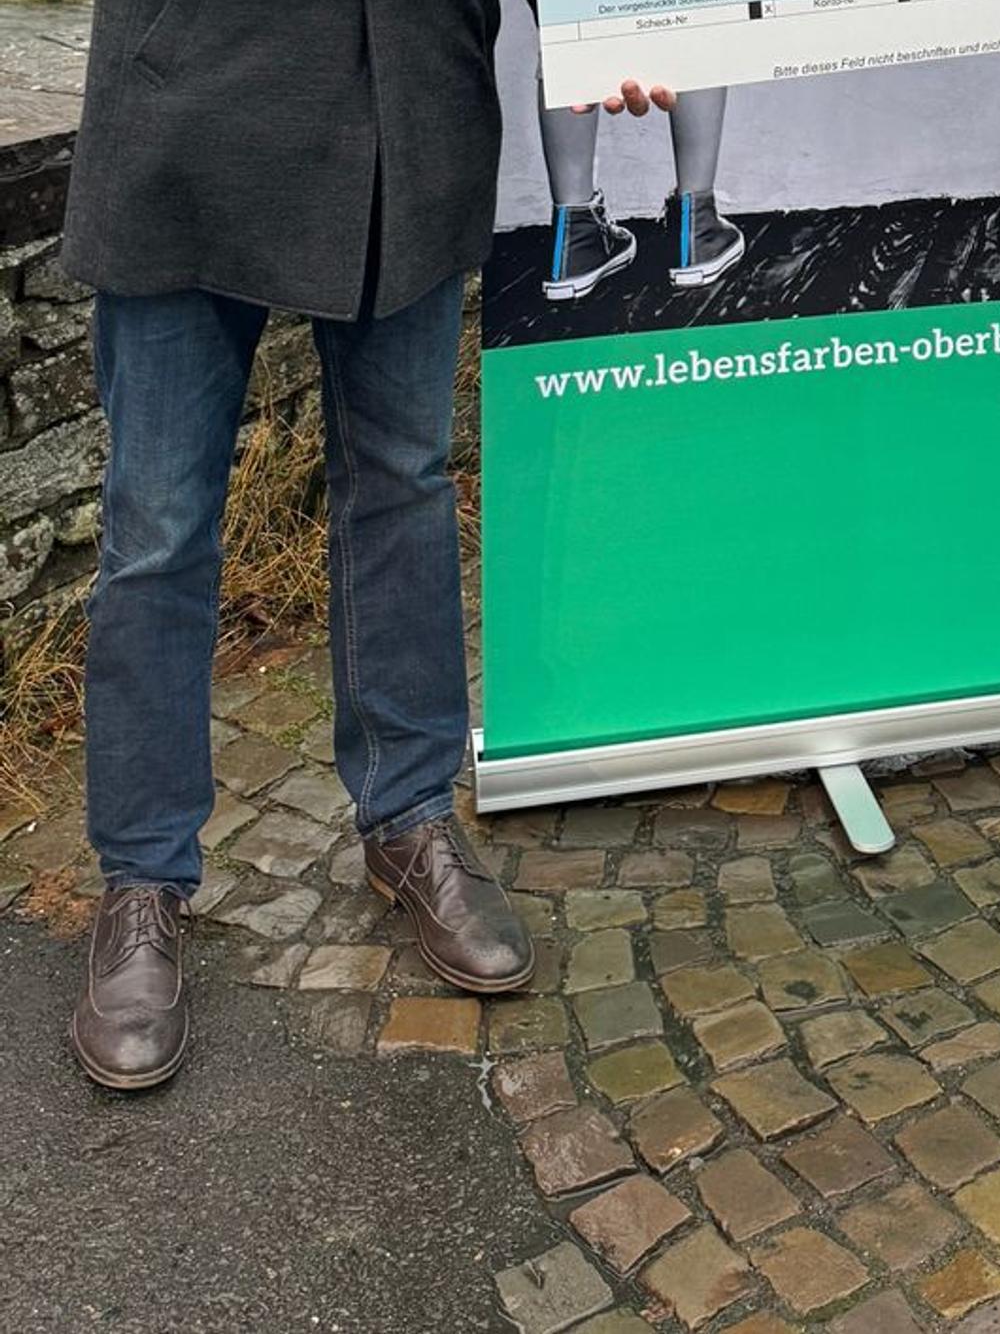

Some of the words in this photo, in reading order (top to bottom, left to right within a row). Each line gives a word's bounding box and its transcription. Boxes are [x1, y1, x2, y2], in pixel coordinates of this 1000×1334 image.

[599, 3, 616, 14] Der
[636, 16, 689, 30] Scheck-Nr
[773, 65, 799, 78] Bitte
[801, 61, 838, 74] dieses
[840, 56, 865, 69] Feld
[868, 53, 894, 65] nicht
[958, 43, 979, 54] und
